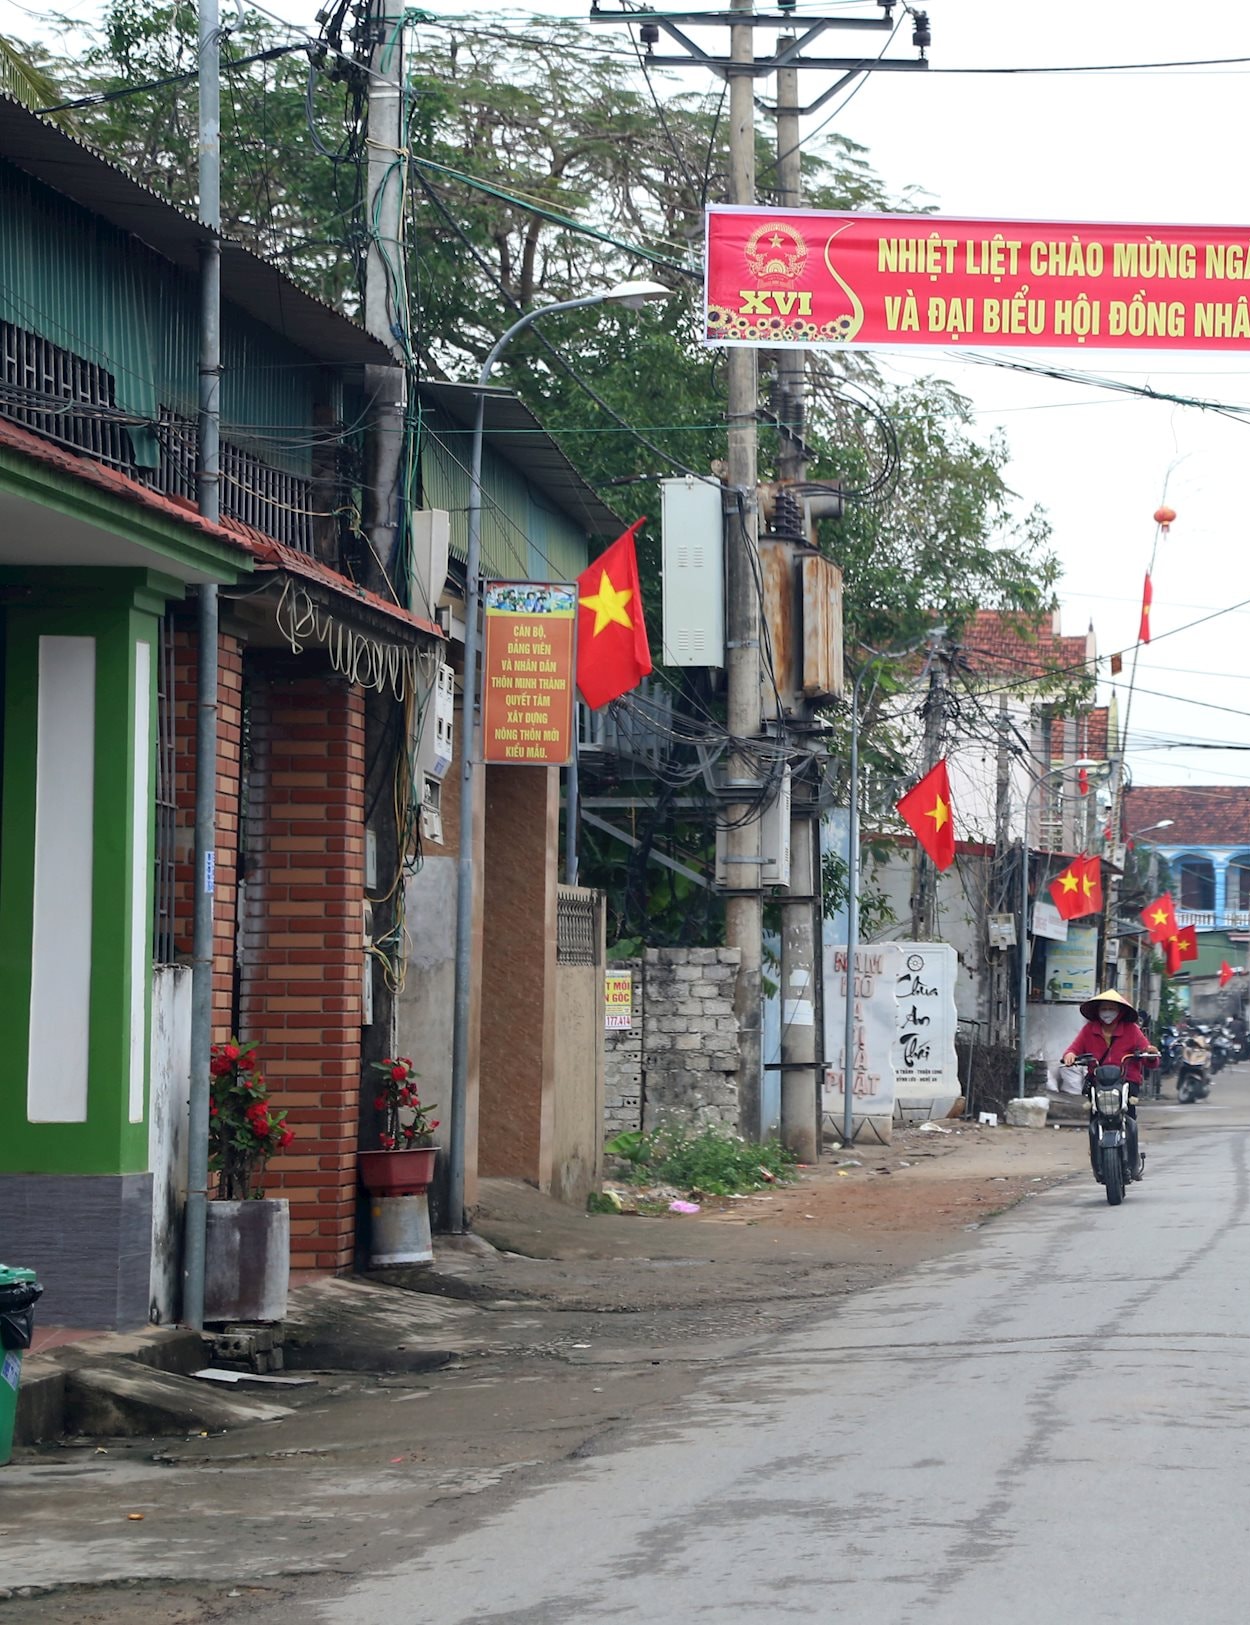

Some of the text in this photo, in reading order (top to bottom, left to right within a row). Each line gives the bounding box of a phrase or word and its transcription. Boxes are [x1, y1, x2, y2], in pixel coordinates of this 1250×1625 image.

[878, 232, 958, 282] NHIỆT
[965, 233, 1022, 283] LIỆT
[1029, 235, 1104, 278] CHÀO
[1112, 236, 1197, 279] MỪNG
[739, 290, 813, 316] XVI
[884, 289, 920, 332] VÀ
[927, 296, 974, 341] ĐẠI
[985, 284, 1046, 335] BIỂU
[1054, 292, 1101, 343] HỘI
[1108, 289, 1186, 337] ĐỒNG
[532, 643, 551, 656] VIÊN
[501, 659, 514, 671] VÀ
[514, 660, 537, 672] NHÂN
[491, 676, 566, 690] THÔN MINH THÀNH
[506, 691, 551, 707] QUYẾT TÂM
[507, 711, 523, 723] XÂY
[495, 728, 560, 742] NÔNG THÔN MỚI
[506, 742, 524, 758] KIỂU
[901, 1005, 930, 1029] An
[899, 1033, 931, 1067] Thái
